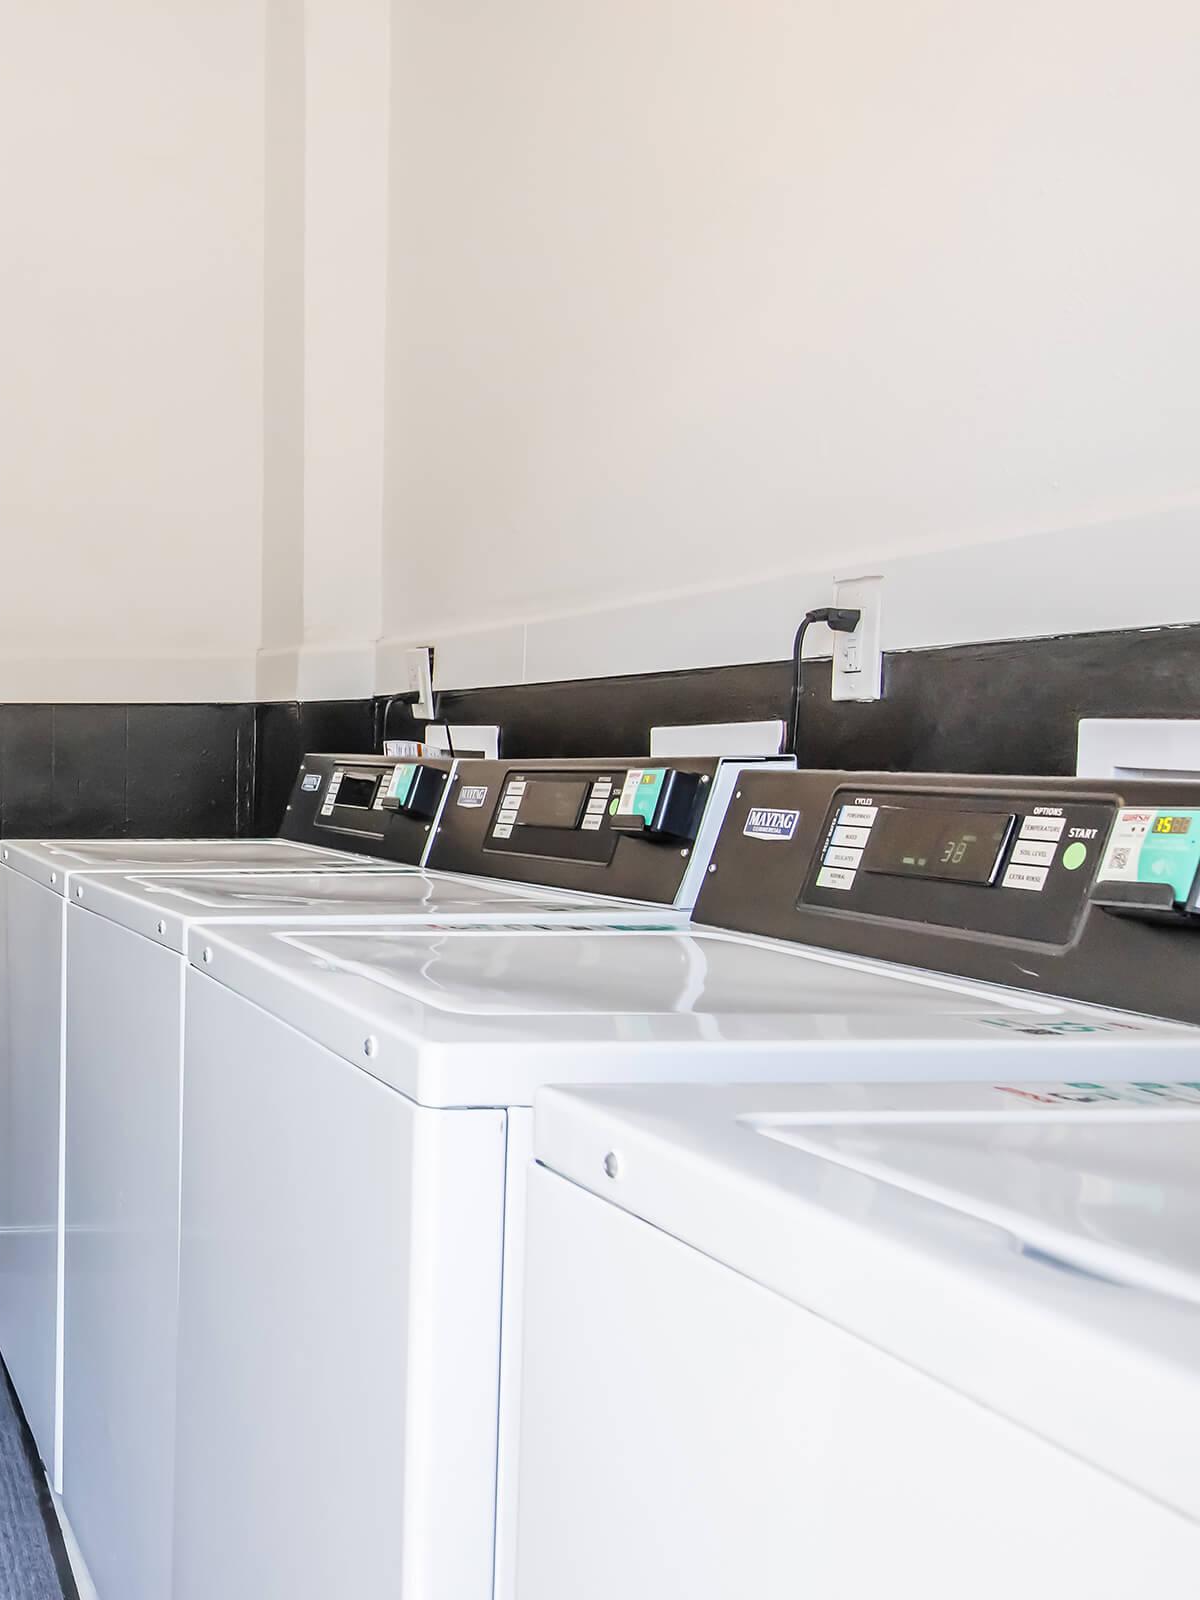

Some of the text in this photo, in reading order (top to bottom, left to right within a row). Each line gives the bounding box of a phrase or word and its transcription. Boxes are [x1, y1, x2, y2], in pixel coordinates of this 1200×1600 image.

[1033, 806, 1064, 817] OPTIONS
[749, 811, 795, 829] MAYTAG
[1068, 827, 1099, 840] START
